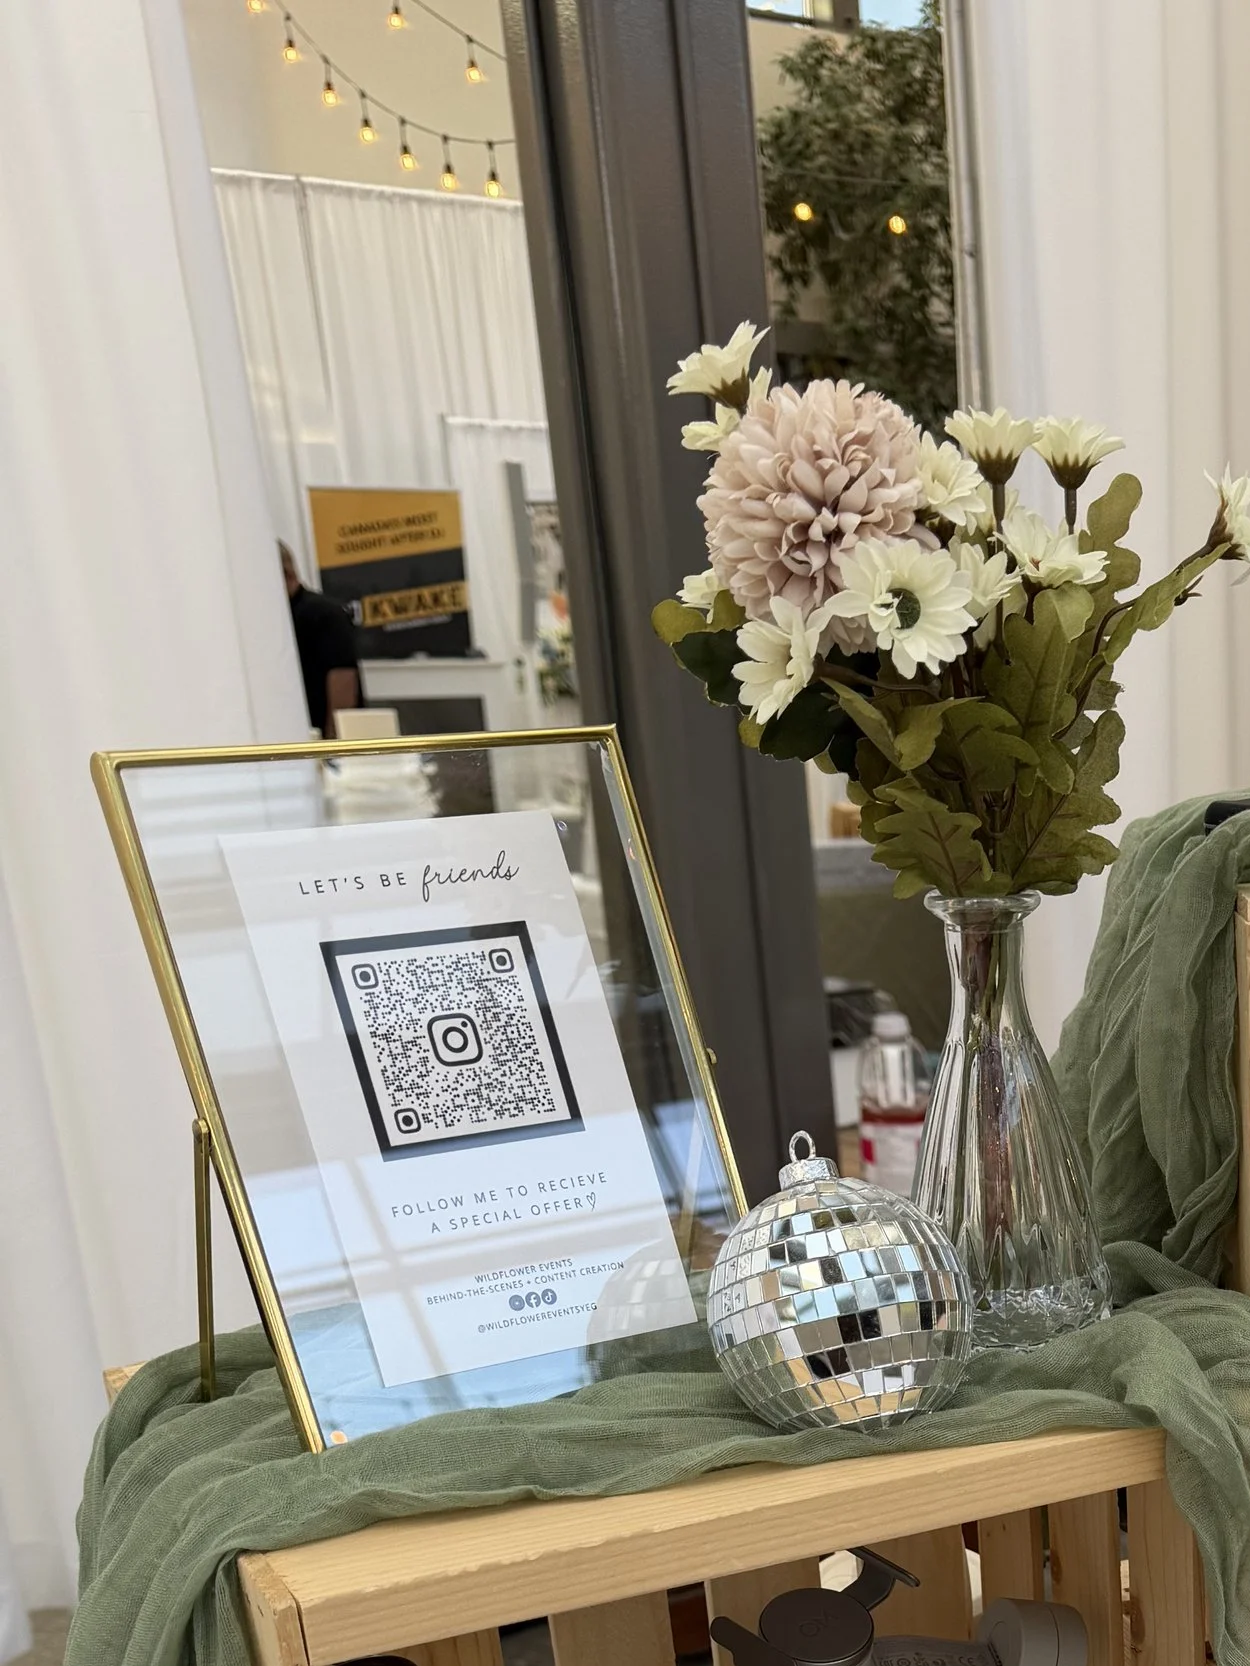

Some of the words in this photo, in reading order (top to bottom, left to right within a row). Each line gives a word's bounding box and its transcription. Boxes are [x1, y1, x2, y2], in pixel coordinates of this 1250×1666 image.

[299, 876, 364, 895] LET'S
[381, 872, 407, 887] BE
[421, 850, 520, 902] friends
[391, 1195, 464, 1217] FOLLOW
[474, 1190, 498, 1204] ME
[506, 1185, 528, 1199] TO
[538, 1172, 607, 1193] RECIEVE
[431, 1222, 440, 1233] A
[450, 1208, 521, 1230] SPECIAL
[530, 1197, 583, 1216] OFFER
[427, 1281, 524, 1305] BEHIND-THE-SCENES
[534, 1269, 577, 1285] CONTENT
[580, 1261, 624, 1277] CREATION
[474, 1264, 537, 1284] WILDFLOWER
[539, 1259, 573, 1271] EVENTS
[478, 1302, 597, 1334] @WILDFLOWEREVENTSYEG
